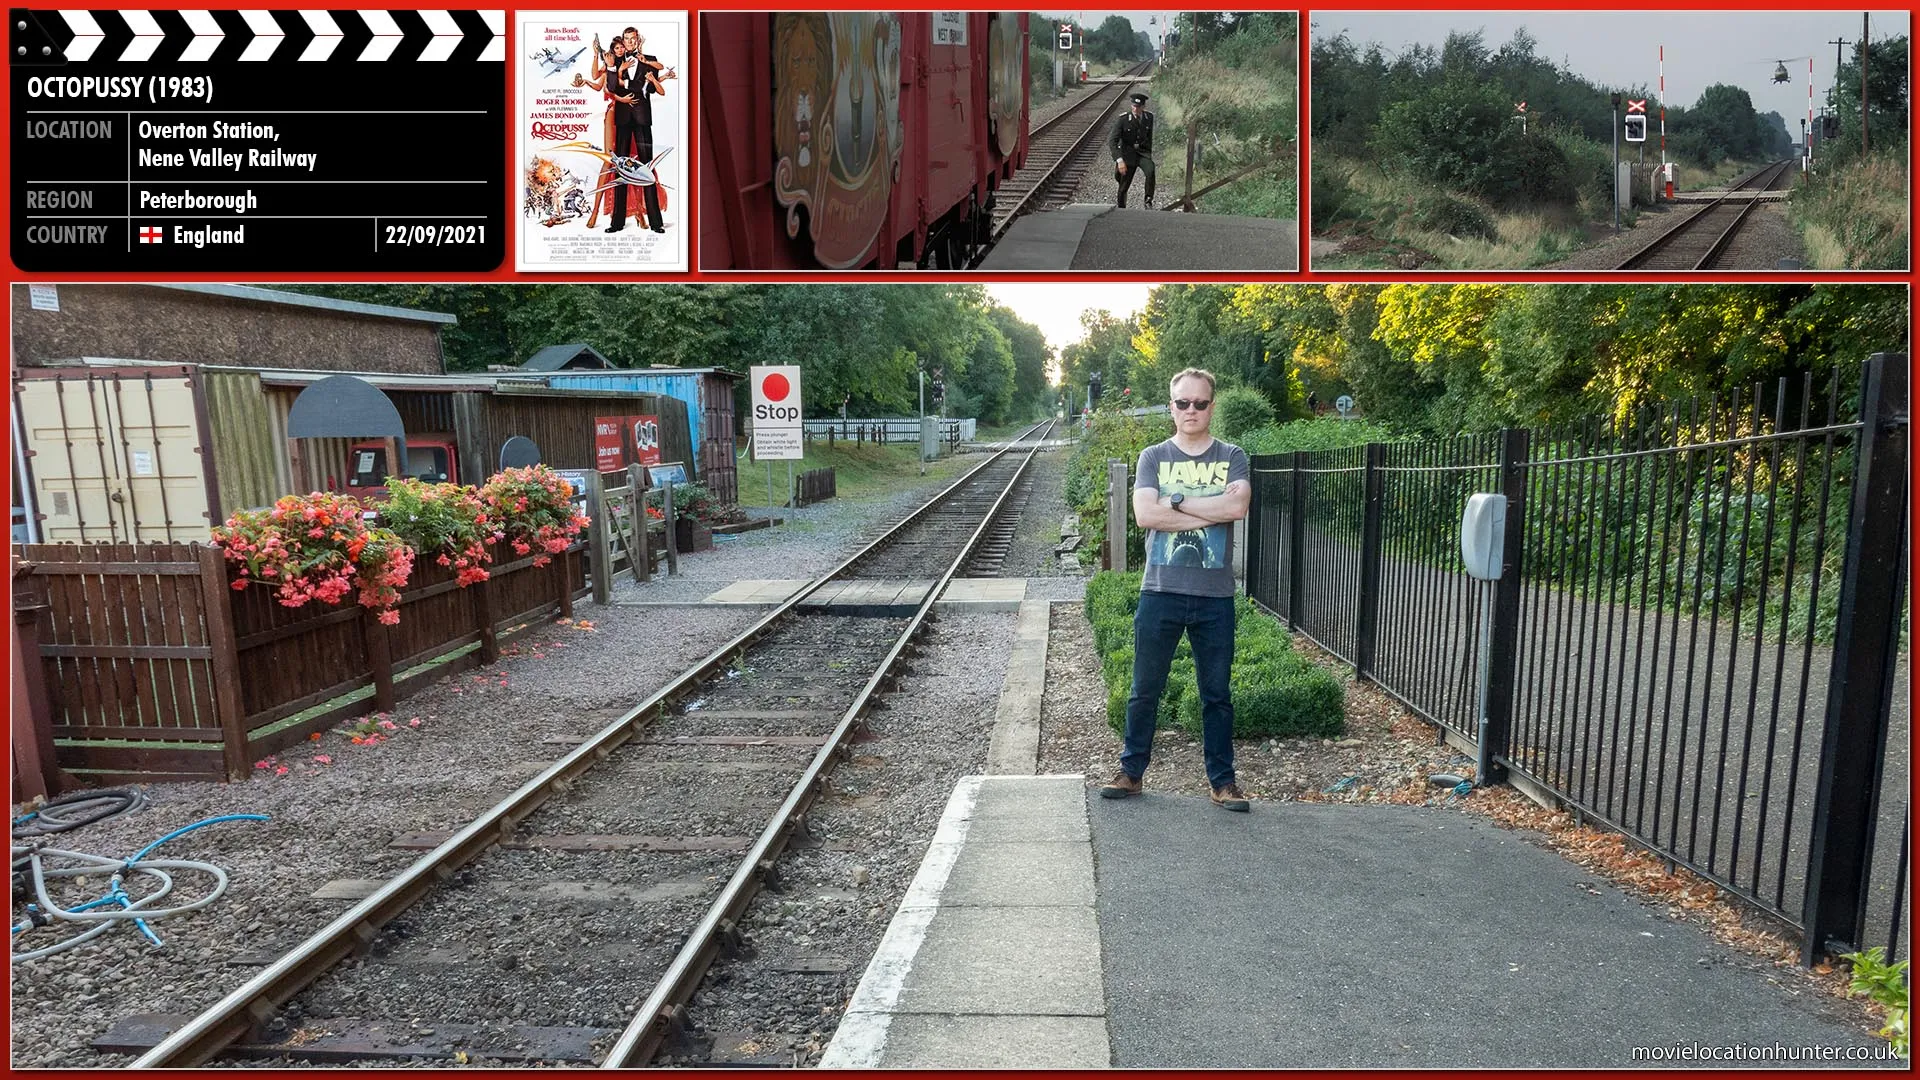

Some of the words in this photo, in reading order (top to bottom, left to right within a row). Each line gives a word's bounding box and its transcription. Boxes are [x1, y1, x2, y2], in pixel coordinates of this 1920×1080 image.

[531, 121, 589, 137] OCTOPUSSY
[755, 404, 799, 423] Stop
[1157, 460, 1230, 486] JAWS
